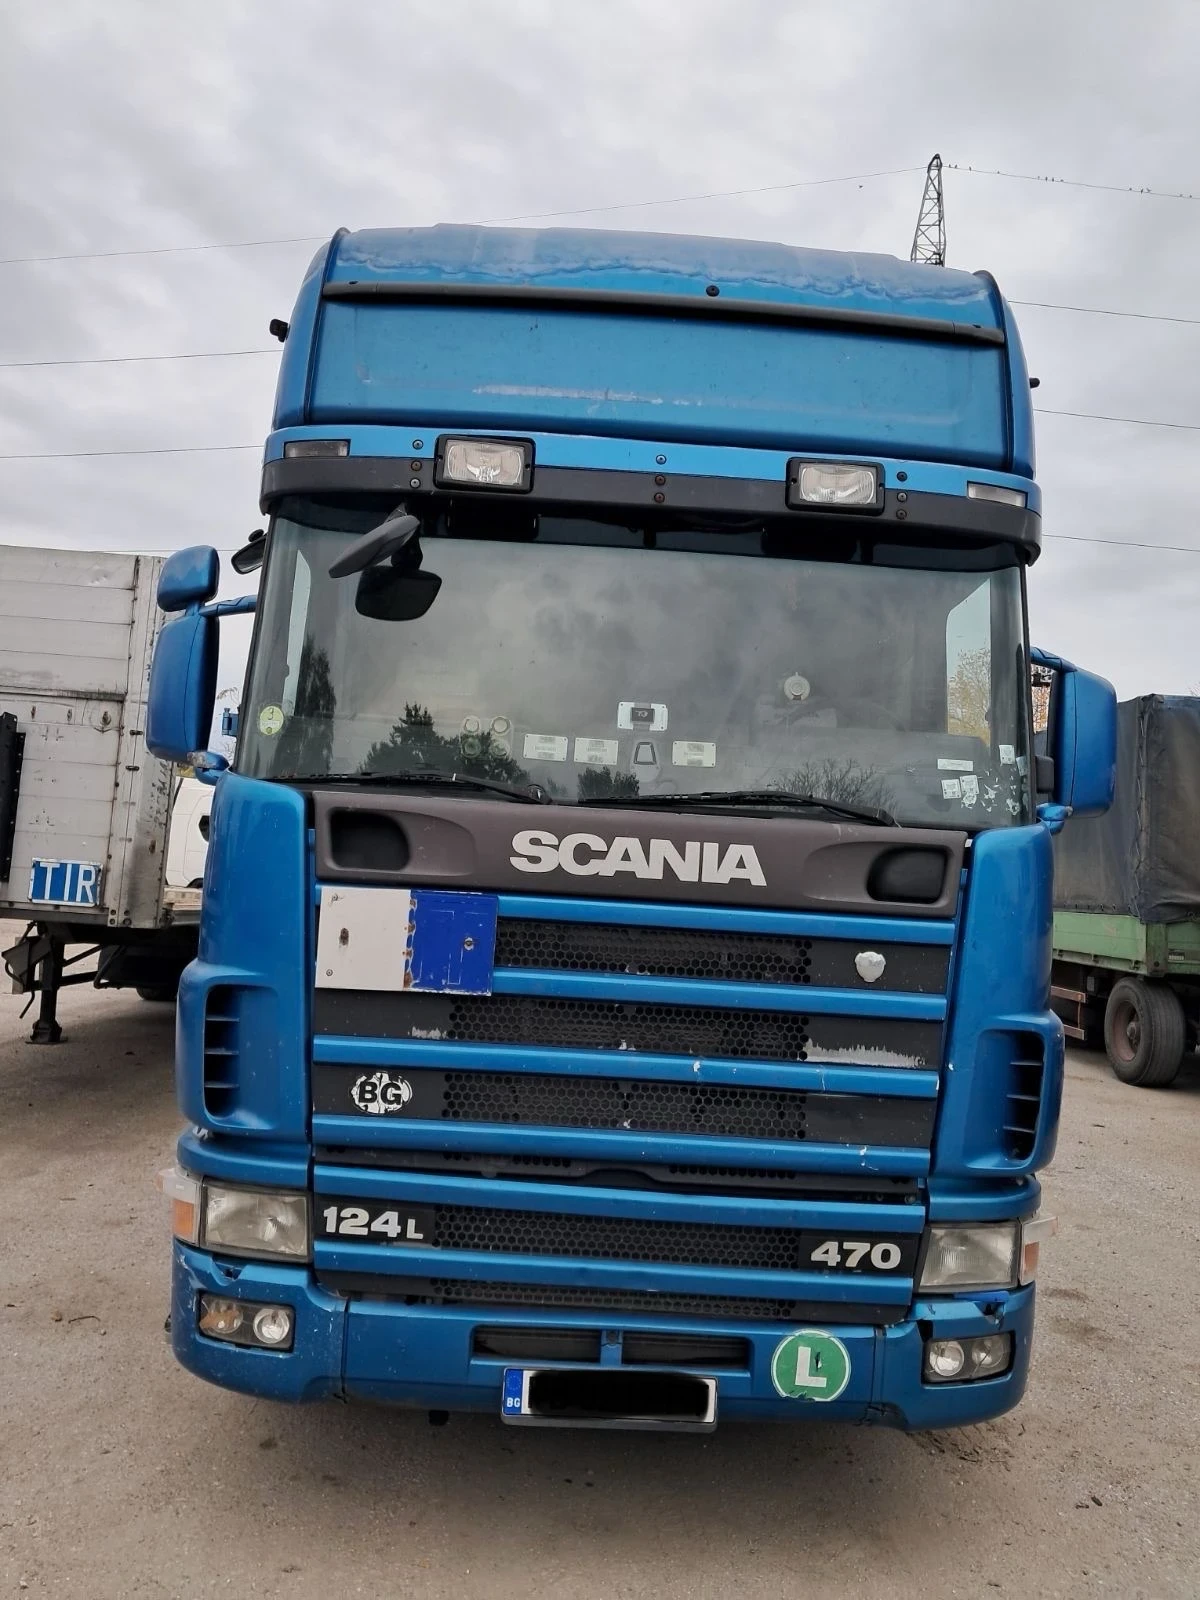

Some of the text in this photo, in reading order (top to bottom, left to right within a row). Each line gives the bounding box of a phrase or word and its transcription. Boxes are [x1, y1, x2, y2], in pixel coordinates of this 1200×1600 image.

[509, 830, 767, 886] SCANIA
[39, 862, 96, 903] TIR
[358, 1081, 402, 1105] BG
[811, 1241, 902, 1270] 470
[794, 1346, 828, 1388] L
[506, 1397, 521, 1408] BG
